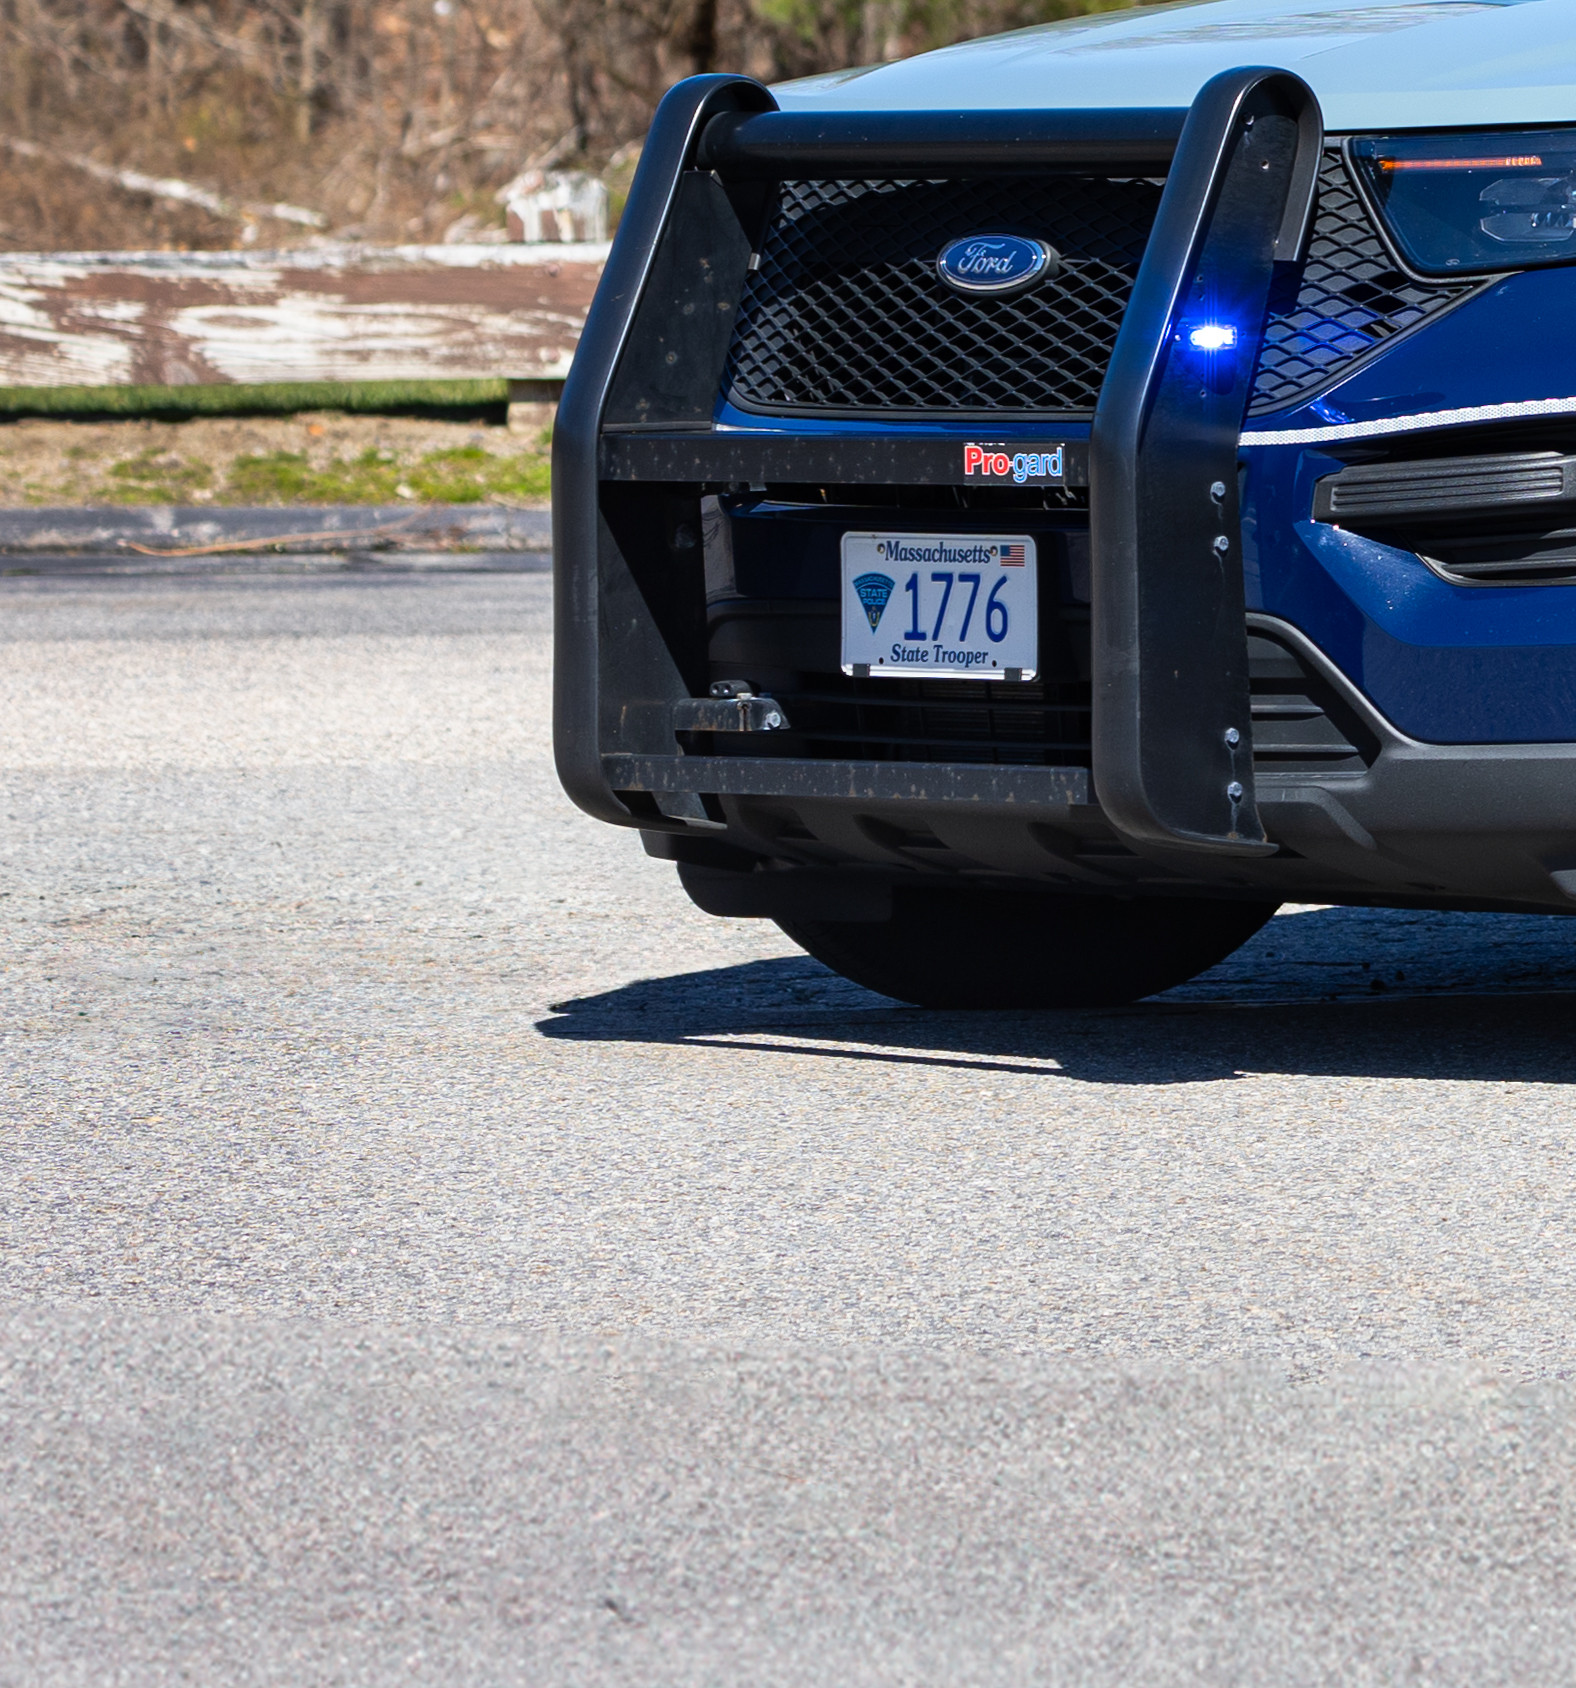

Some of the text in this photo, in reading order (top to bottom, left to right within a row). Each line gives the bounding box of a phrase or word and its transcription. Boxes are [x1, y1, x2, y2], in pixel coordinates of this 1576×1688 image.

[957, 241, 1019, 274] Ford
[964, 444, 1064, 484] Pro-gard
[884, 540, 992, 564] Massachusetts
[860, 588, 888, 598] STATE
[904, 570, 1010, 644] 1776
[890, 643, 989, 668] State Trooper
